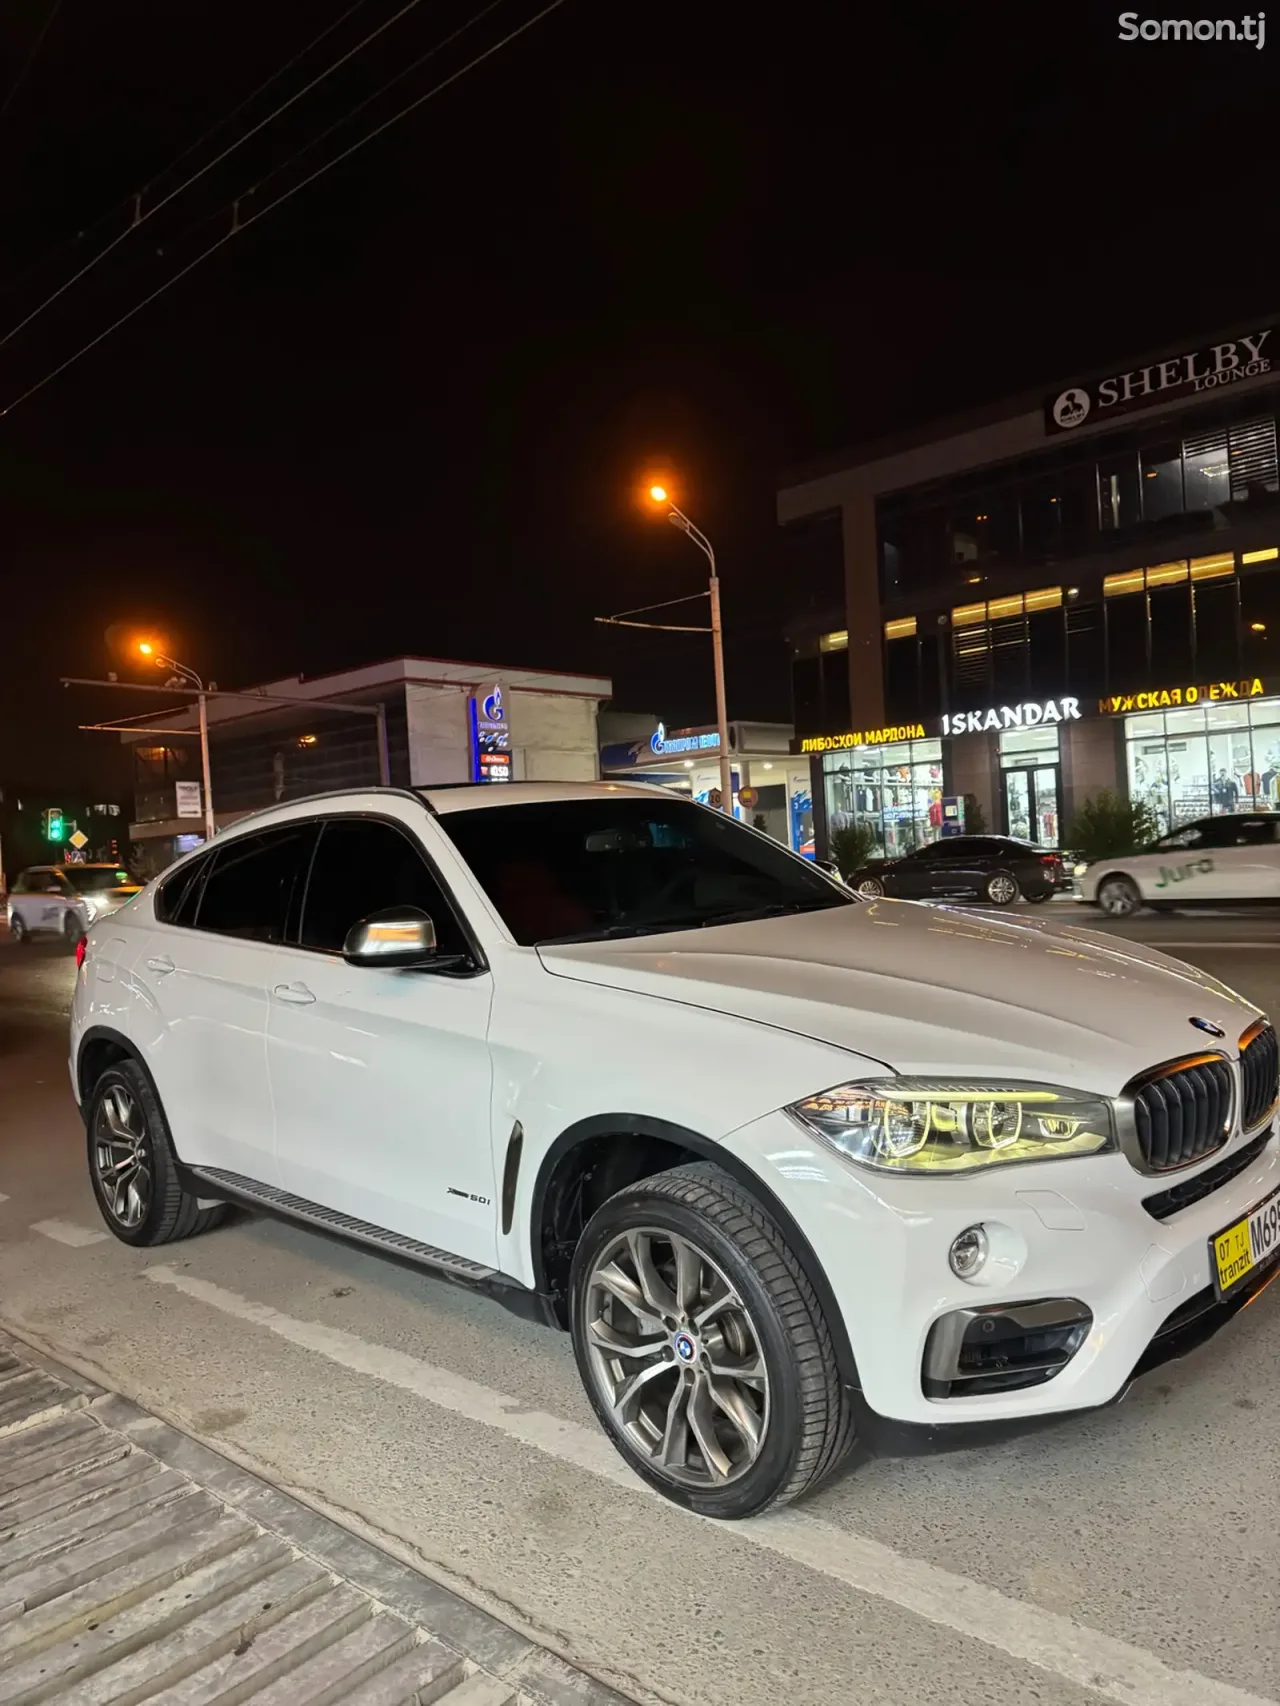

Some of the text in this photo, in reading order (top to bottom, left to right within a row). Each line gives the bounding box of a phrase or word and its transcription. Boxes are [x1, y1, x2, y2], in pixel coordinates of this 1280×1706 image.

[1097, 330, 1272, 408] SHELBY
[1193, 358, 1271, 392] LOUNGE
[1099, 678, 1264, 713] МУЖСКАЯ ОДЕЖДА
[865, 724, 925, 744] МАРДОНА
[942, 697, 1082, 736] ISKANDAR
[1219, 1238, 1230, 1261] 07
[1234, 1232, 1245, 1251] TJ
[1219, 1248, 1251, 1285] tranzit
